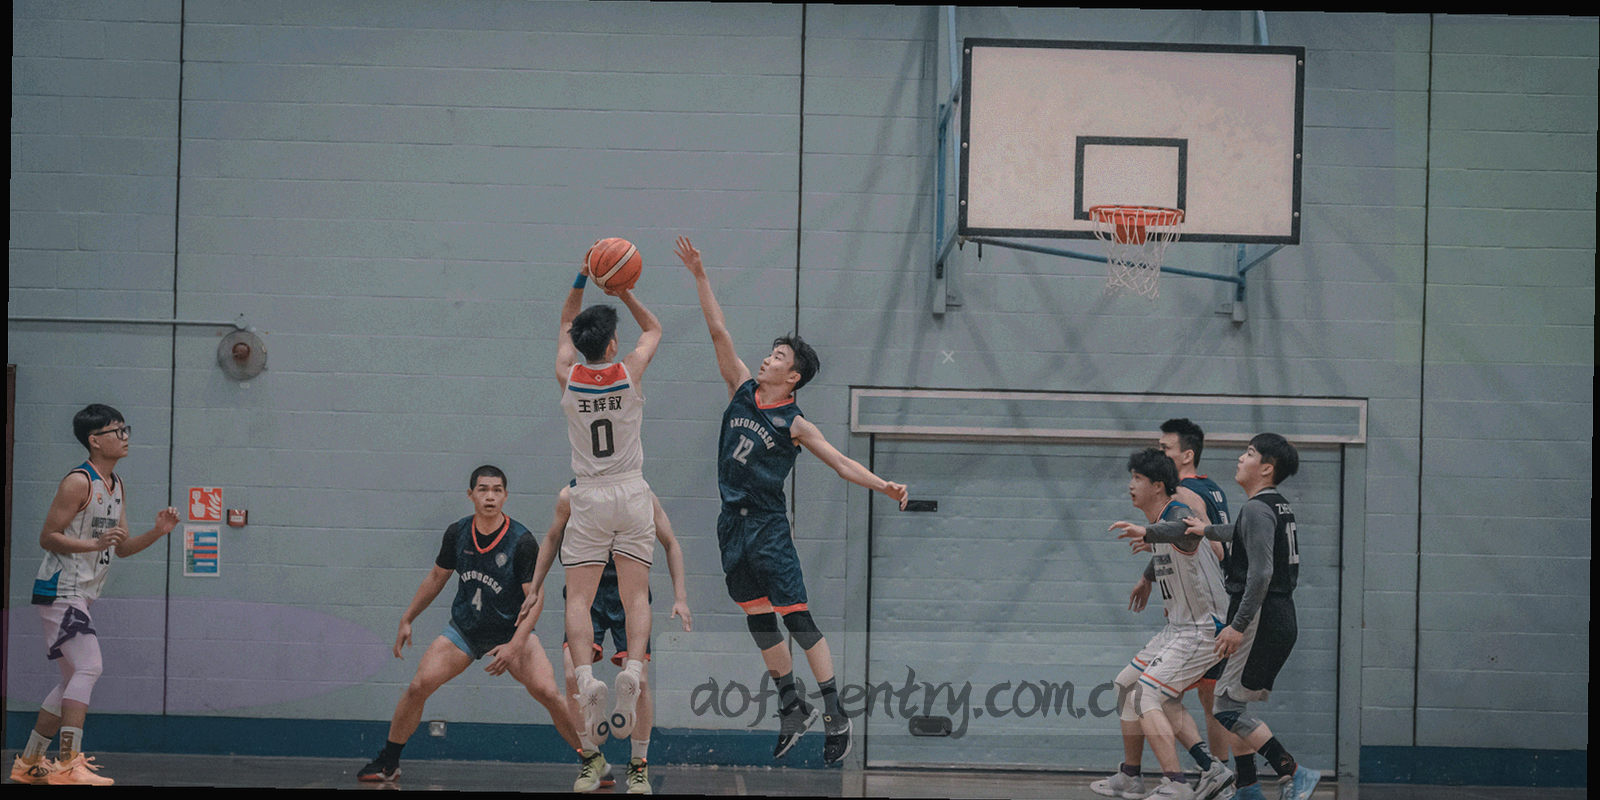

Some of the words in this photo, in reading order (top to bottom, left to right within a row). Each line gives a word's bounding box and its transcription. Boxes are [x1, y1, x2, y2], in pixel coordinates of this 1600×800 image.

[590, 419, 615, 458] 0
[732, 434, 754, 464] 12
[472, 587, 482, 611] 4
